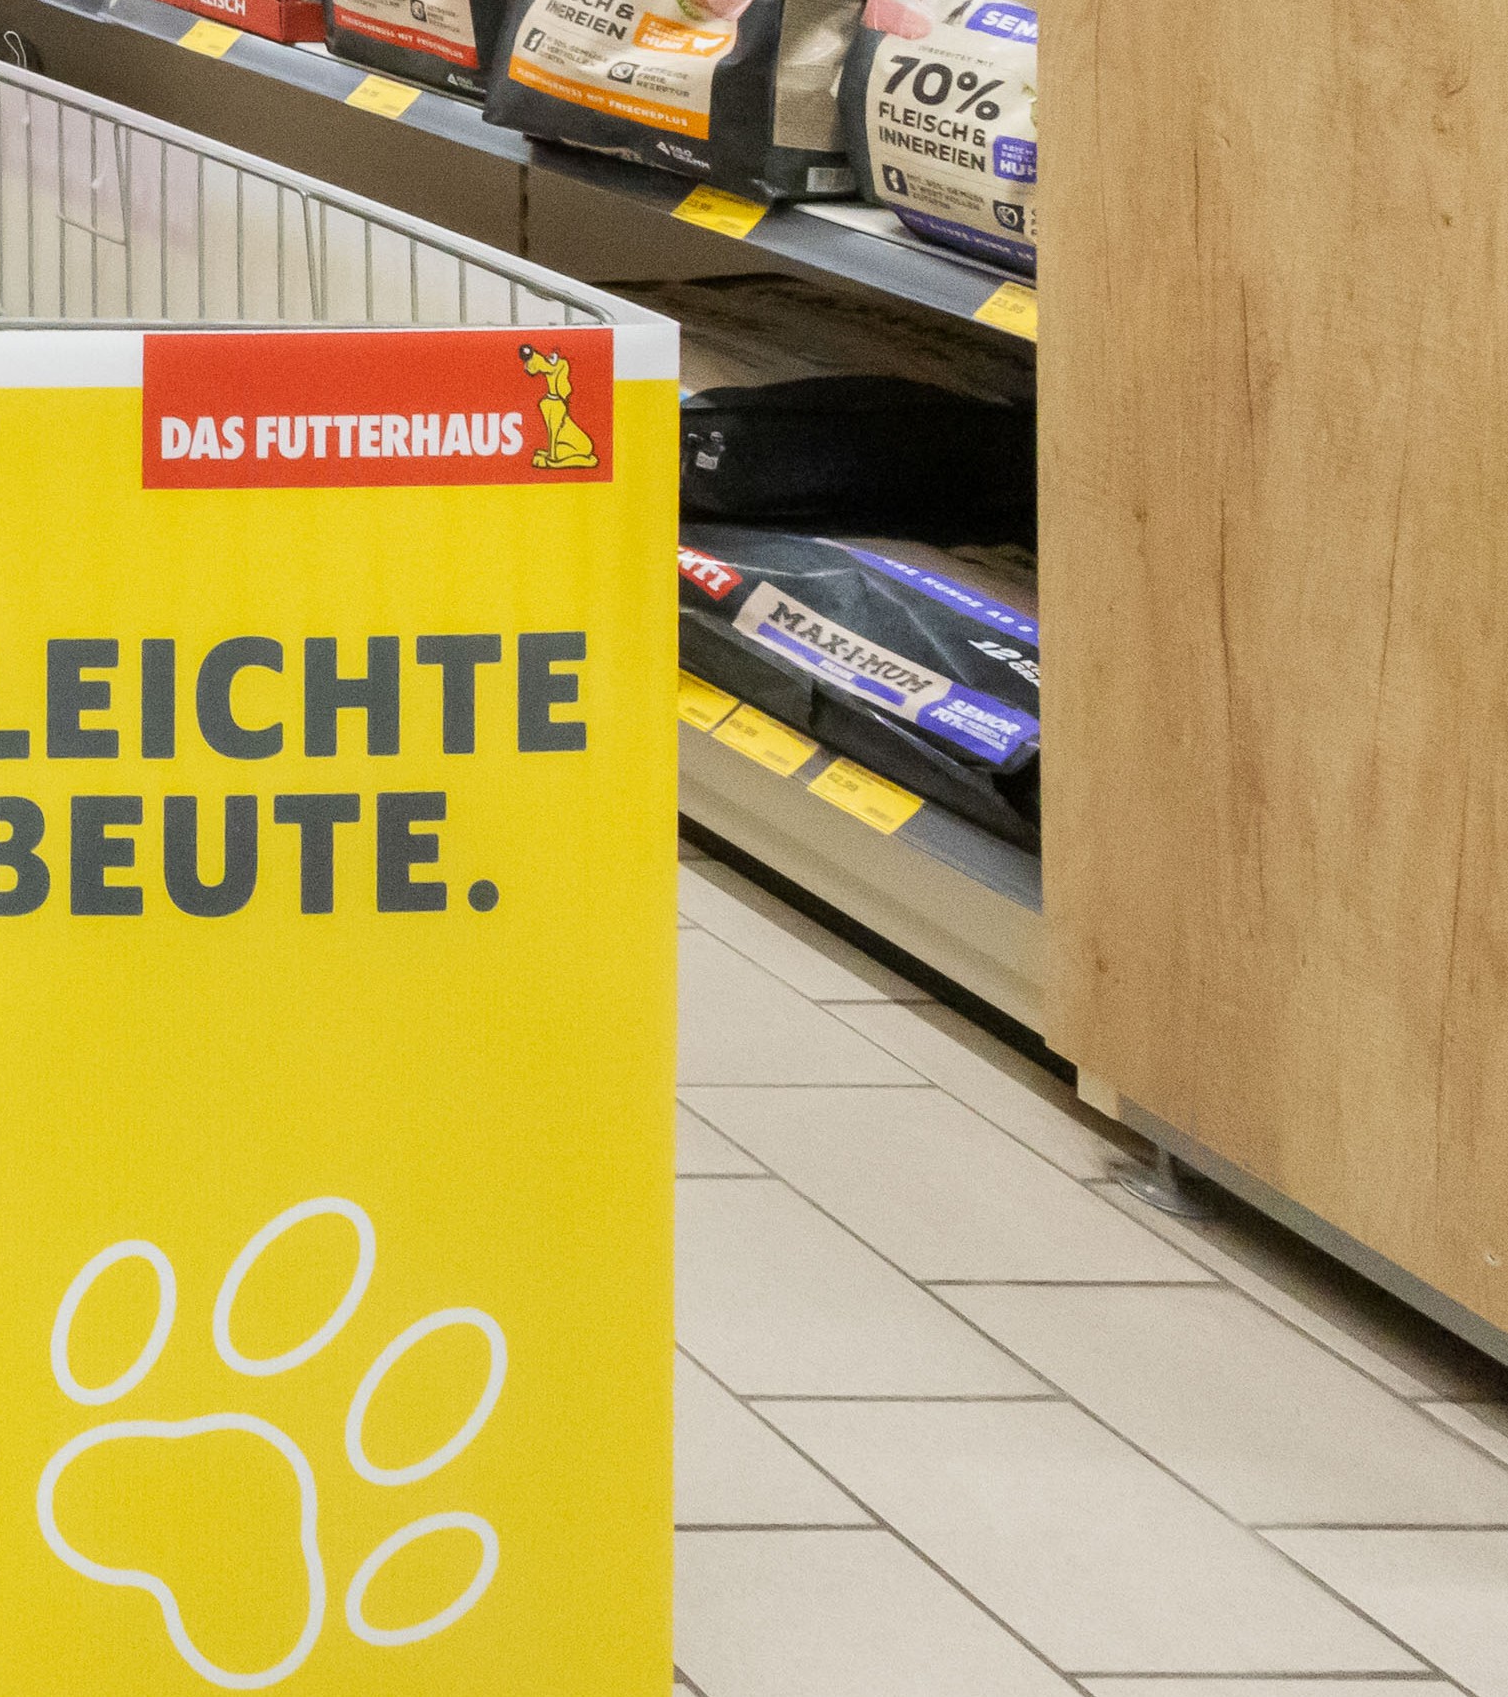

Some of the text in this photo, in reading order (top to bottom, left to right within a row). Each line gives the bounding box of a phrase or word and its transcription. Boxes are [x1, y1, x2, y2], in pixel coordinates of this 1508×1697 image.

[881, 54, 1006, 122] 70%
[878, 102, 971, 143] FLEISCH
[877, 125, 986, 173] INNEREIEN
[161, 412, 523, 462] DAS FUTTERHAUS
[767, 600, 933, 695] MAX-I-MUM
[951, 699, 1021, 735] SENIOR
